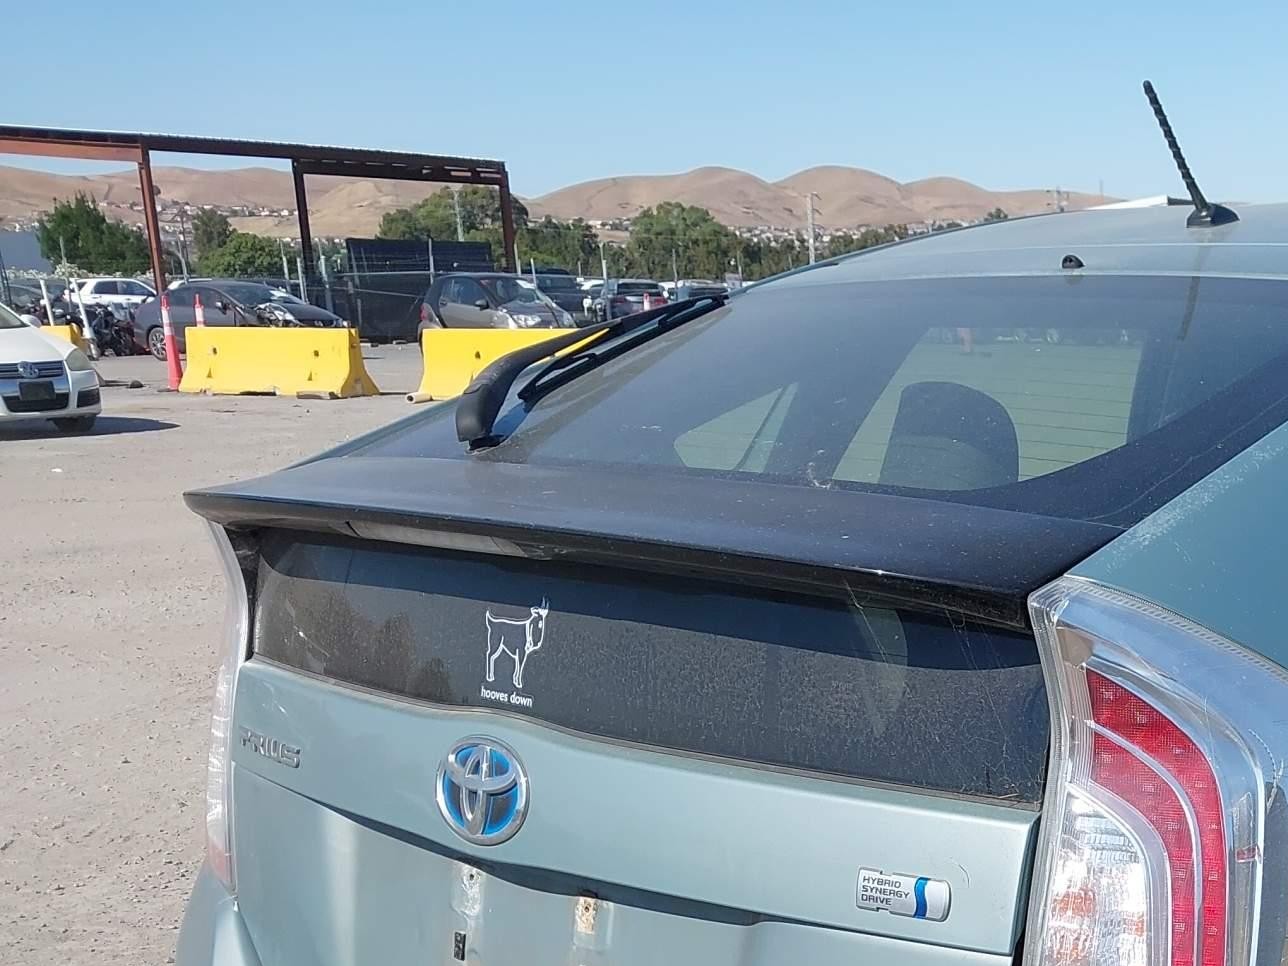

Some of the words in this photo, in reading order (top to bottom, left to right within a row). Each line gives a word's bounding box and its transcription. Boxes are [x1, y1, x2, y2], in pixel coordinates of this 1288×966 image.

[480, 685, 508, 702] hooves
[509, 691, 533, 708] down
[239, 727, 301, 769] PRIUS
[862, 875, 902, 888] HYBRID
[861, 884, 910, 899] SYNERGY
[861, 893, 892, 906] DRIVE
